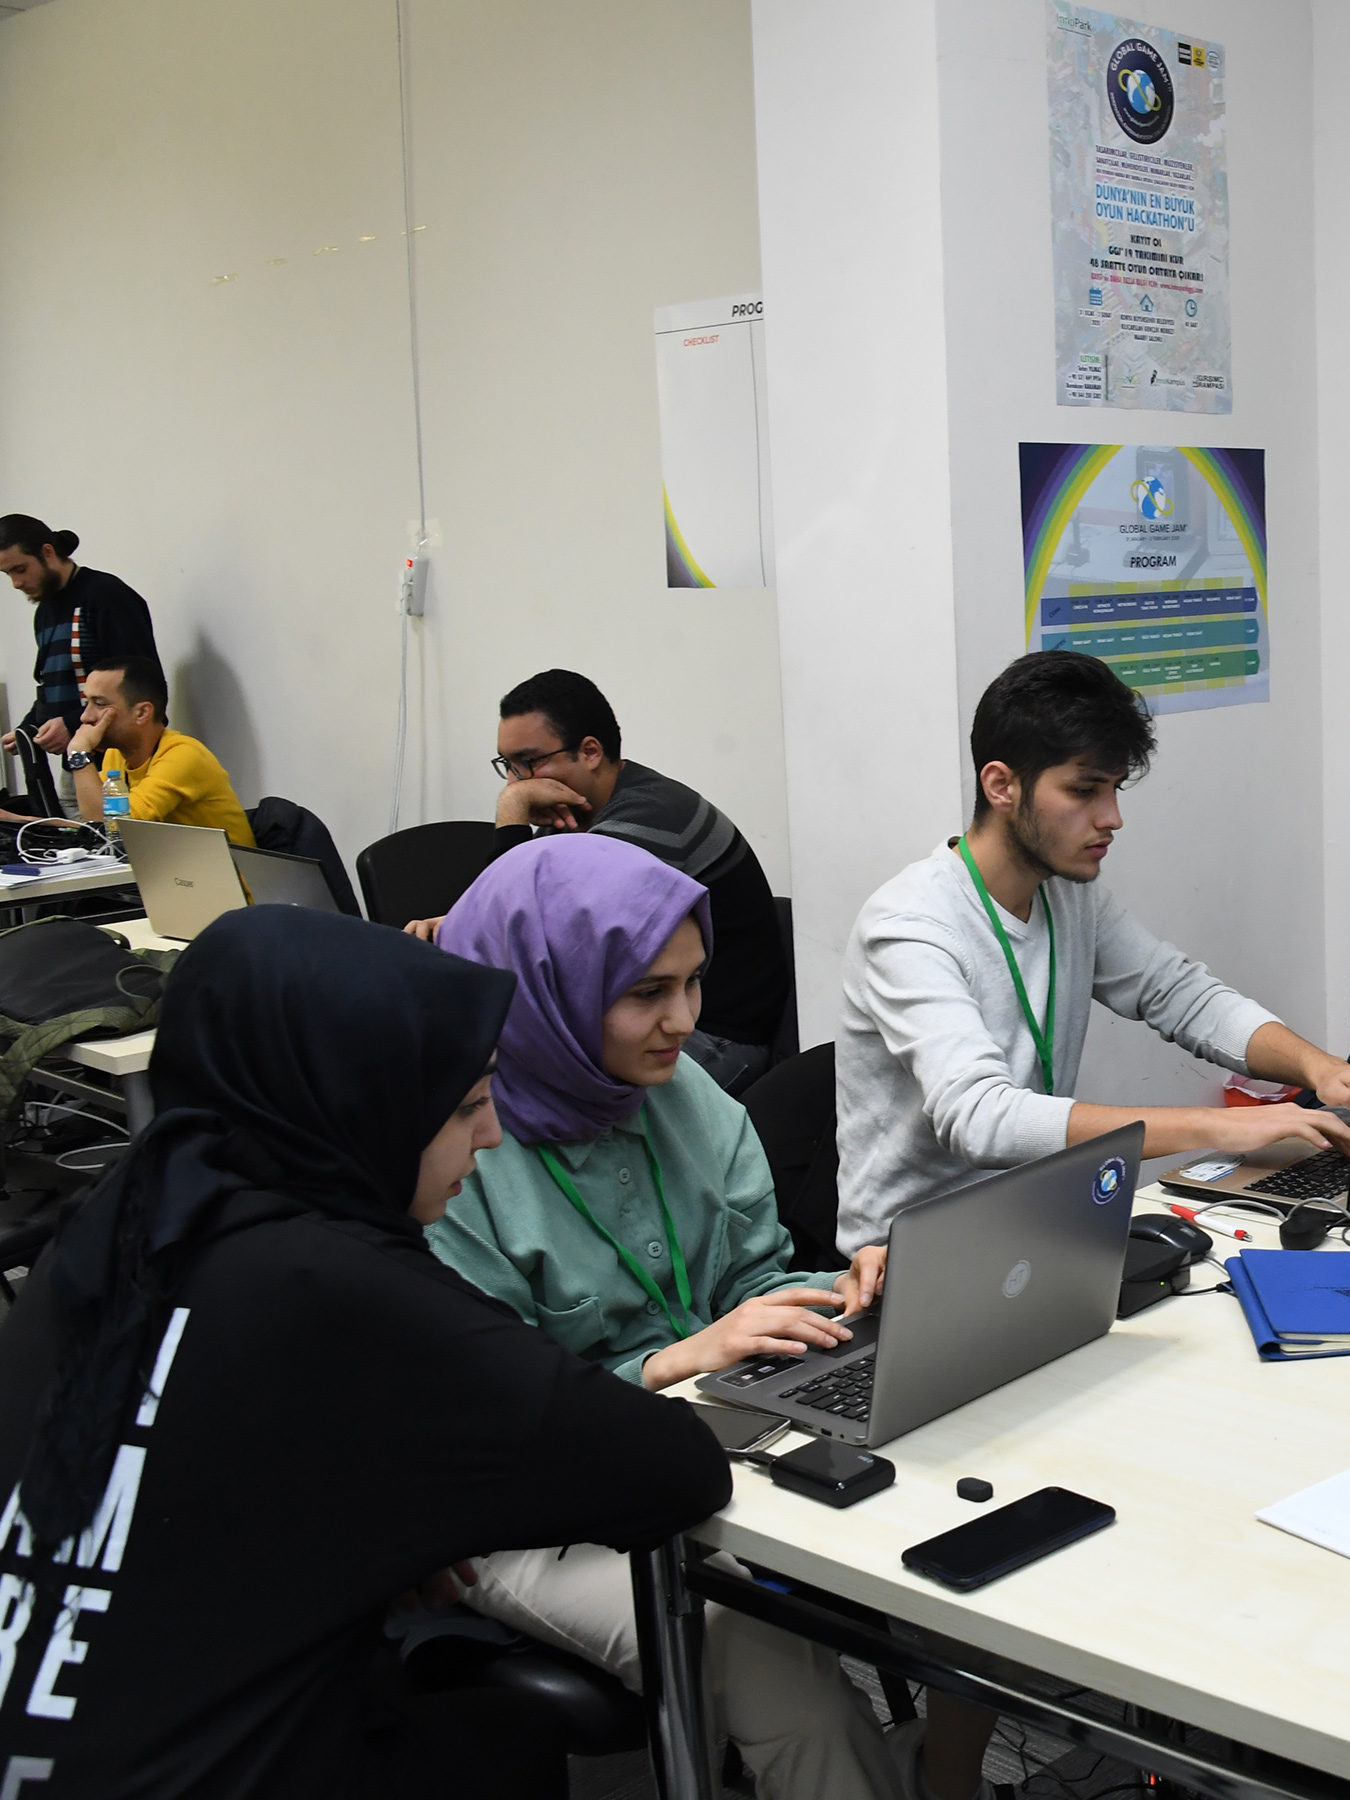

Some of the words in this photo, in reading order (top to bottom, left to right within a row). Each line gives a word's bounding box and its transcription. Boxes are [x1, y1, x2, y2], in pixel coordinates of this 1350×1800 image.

[1110, 43, 1135, 71] GLOBAL
[1137, 43, 1158, 62] GAME
[1096, 181, 1147, 207] DÜNYA'NIN
[1150, 193, 1161, 209] EN
[1165, 193, 1195, 215] BÜYÜK
[1096, 202, 1123, 220] OYUN
[1126, 207, 1195, 232] HACKATHON'U
[1130, 234, 1151, 246] KAYIT
[1169, 255, 1184, 265] KUR
[1128, 263, 1147, 274] OYUN
[683, 335, 719, 347] CHECKLIST
[1119, 524, 1148, 534] GLOBAL
[1149, 524, 1170, 533] GAME
[1129, 555, 1177, 568] PROGRAM
